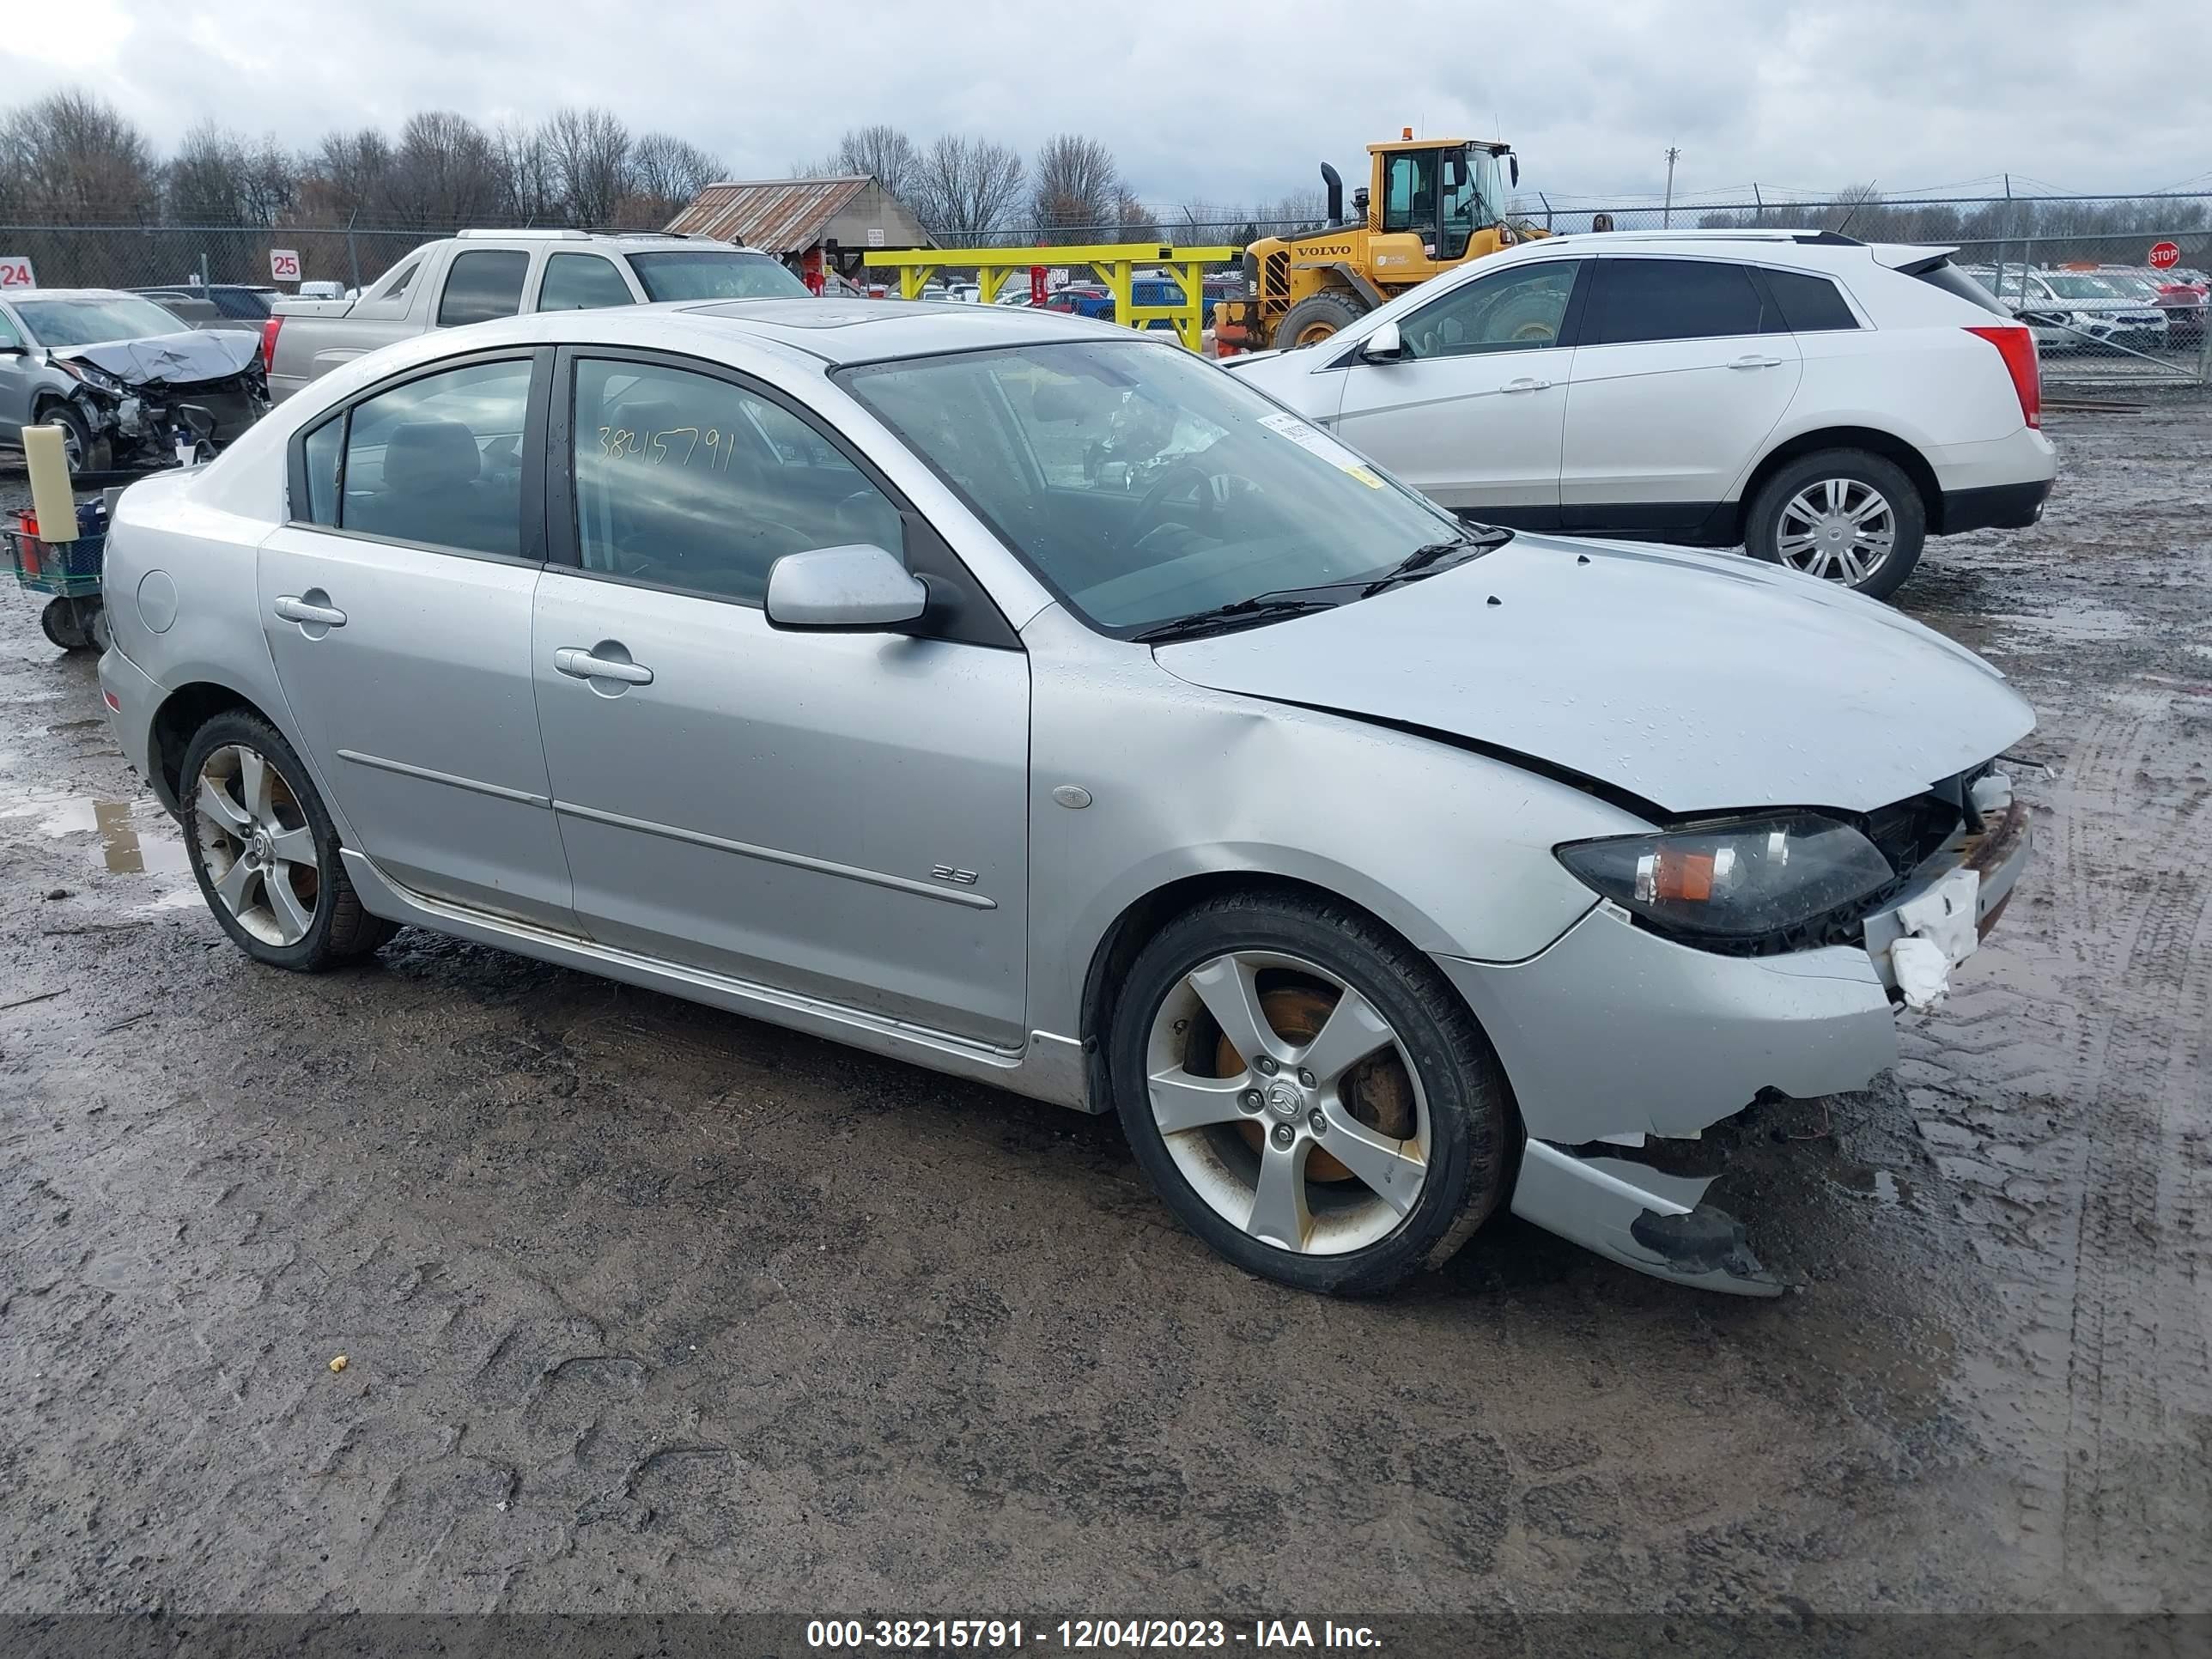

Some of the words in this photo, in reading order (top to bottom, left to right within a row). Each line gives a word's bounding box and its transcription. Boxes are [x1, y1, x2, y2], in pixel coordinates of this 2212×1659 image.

[1296, 246, 1352, 256] VOLVO
[2151, 249, 2178, 263] STOP
[0, 264, 31, 285] 24
[274, 256, 297, 275] 25
[599, 427, 735, 472] 38215791
